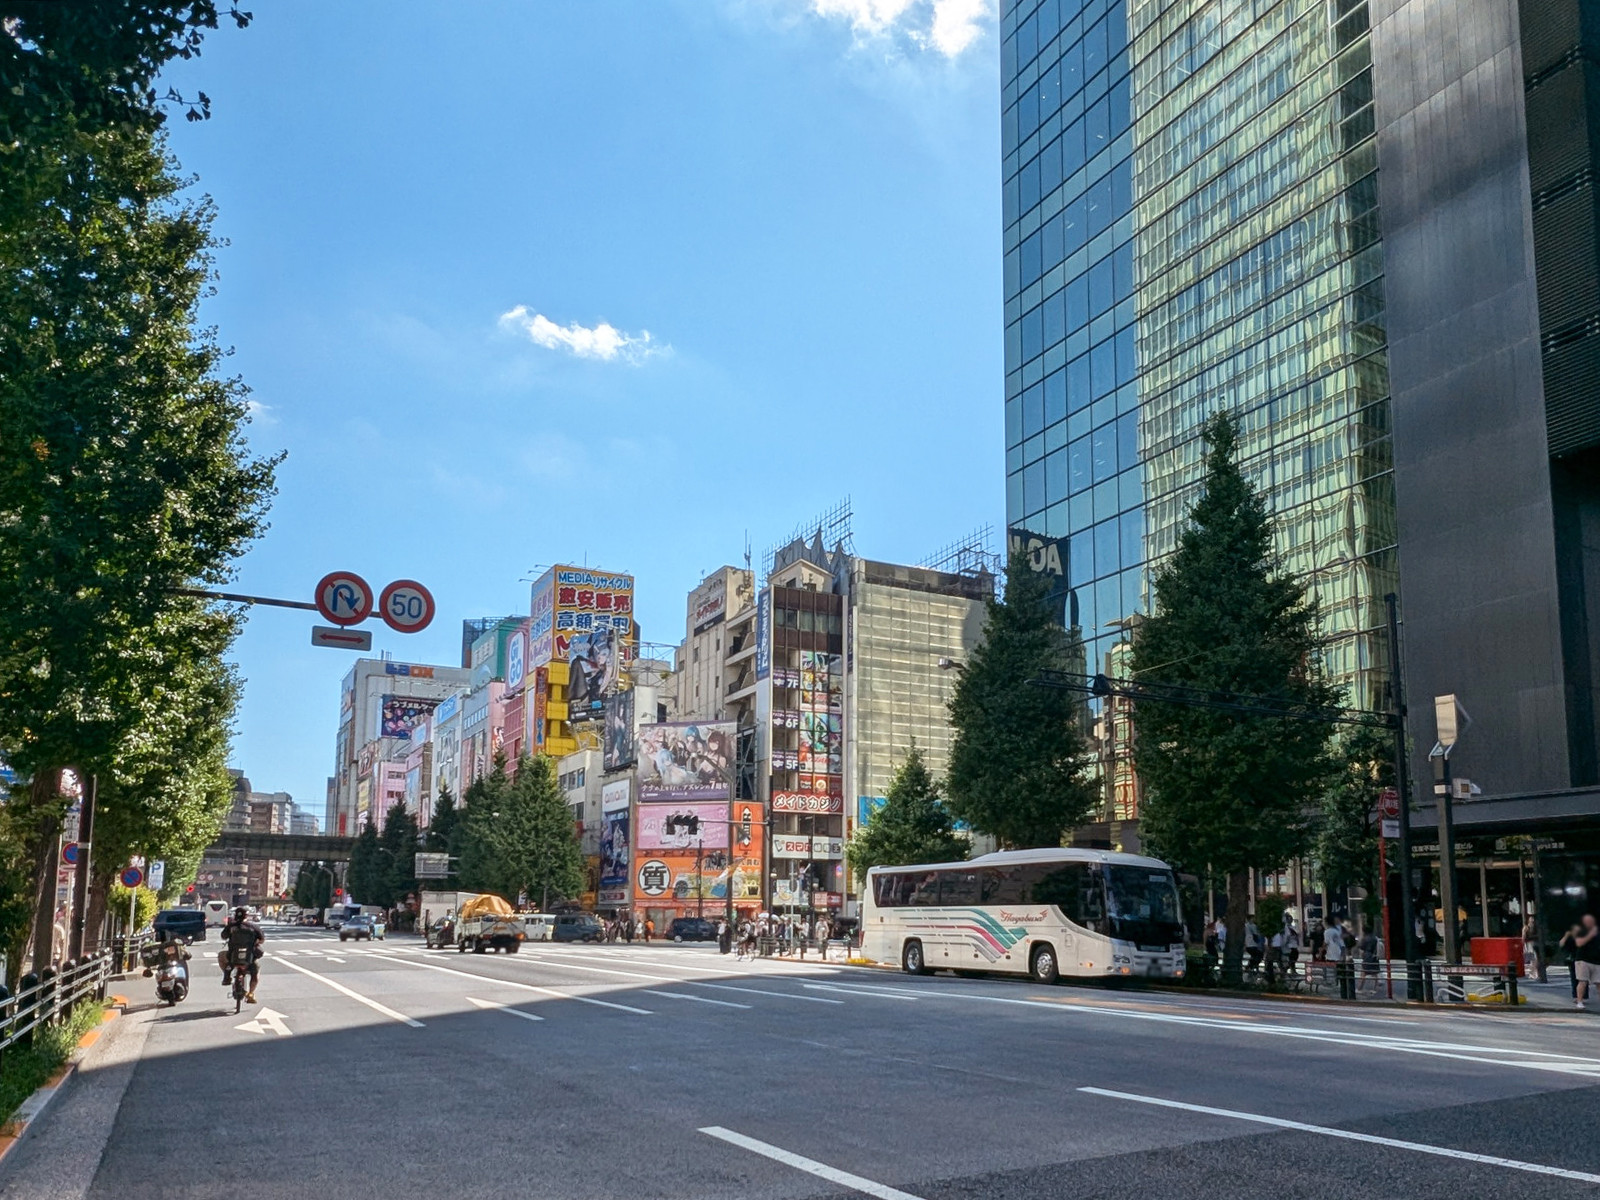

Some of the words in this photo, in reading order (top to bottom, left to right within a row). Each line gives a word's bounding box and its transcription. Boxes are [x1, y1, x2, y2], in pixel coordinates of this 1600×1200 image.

[392, 593, 423, 619] 50
[558, 587, 631, 611] 激安販売
[787, 678, 799, 689] 7F
[785, 718, 799, 728] 6F
[785, 760, 799, 769] 5F
[775, 794, 840, 811] メイドカジノ
[151, 863, 162, 874] P
[642, 866, 668, 891] 質
